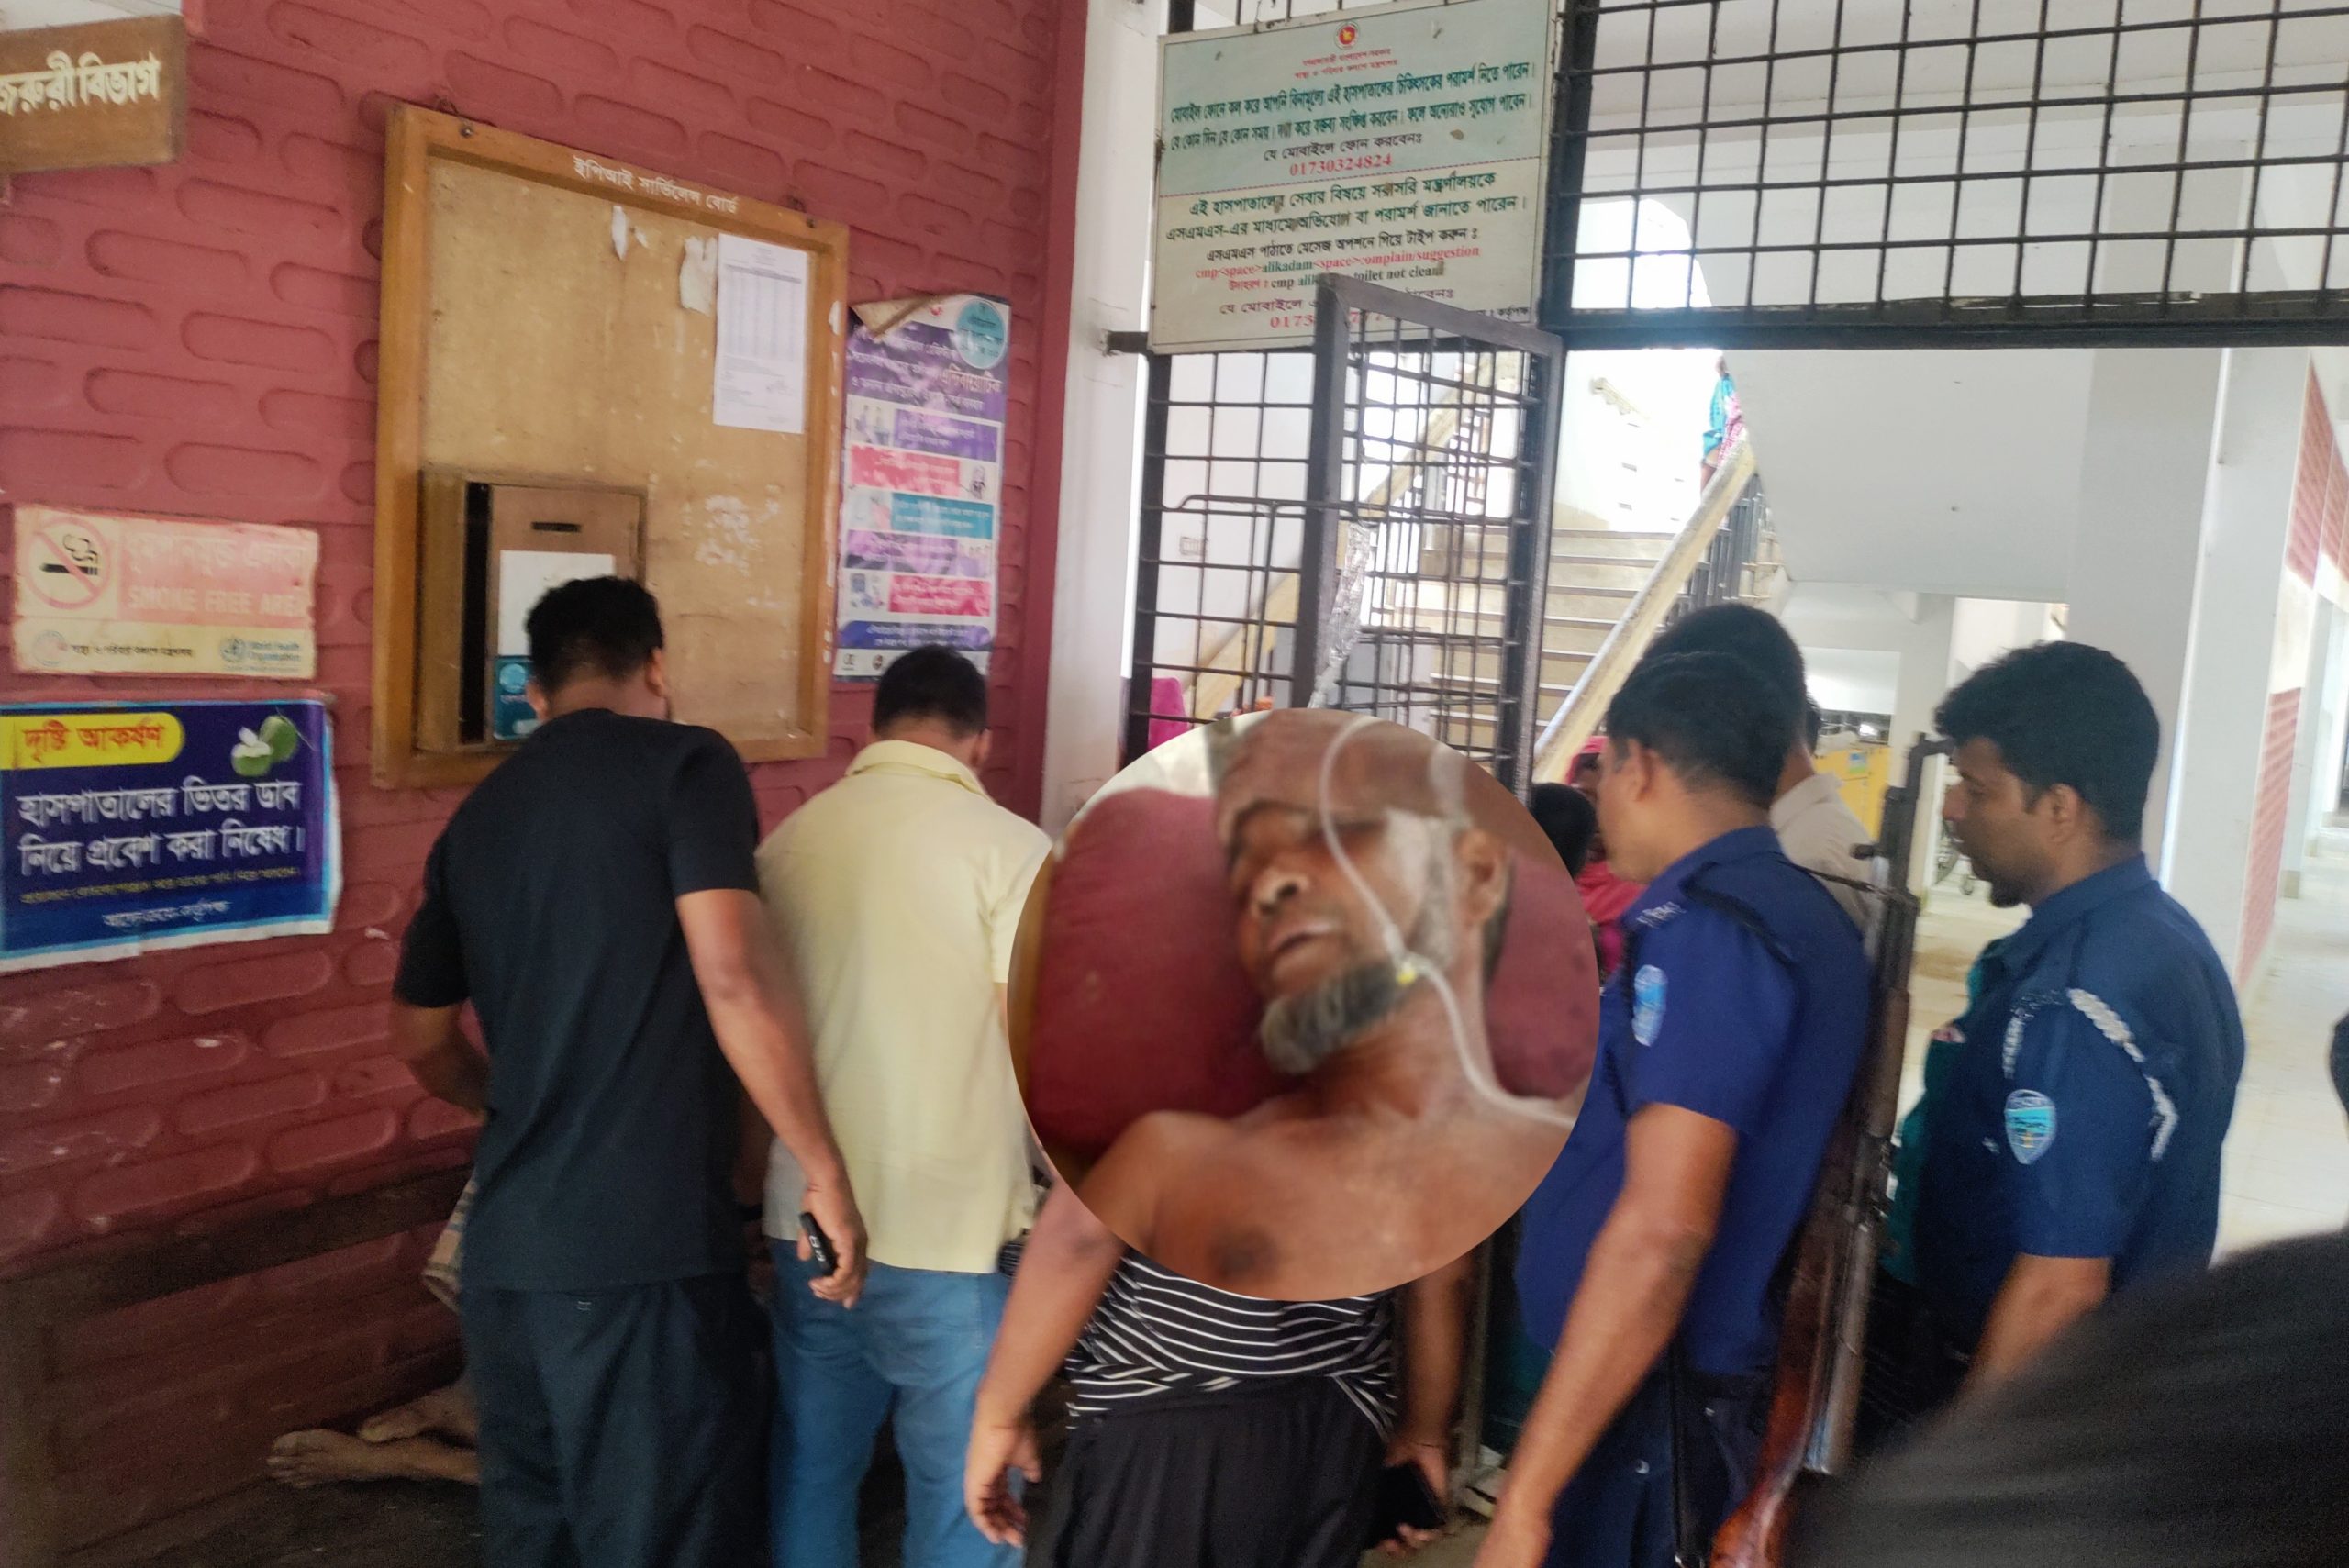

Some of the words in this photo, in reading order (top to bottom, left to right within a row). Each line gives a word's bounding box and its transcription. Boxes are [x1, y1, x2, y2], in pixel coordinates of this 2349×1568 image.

[77, 51, 161, 106] বিভাগ
[1171, 102, 1201, 123] মোবাইল
[1263, 90, 1287, 111] আপনি
[1328, 84, 1341, 103] এই
[1342, 81, 1395, 103] হাসপাতালের
[1478, 62, 1499, 83] নিতে
[1264, 149, 1278, 161] যে
[1282, 141, 1335, 160] মোবাইলে
[1340, 138, 1369, 152] ফোন
[1289, 153, 1393, 176] 01730324824
[705, 194, 740, 214] বোর্ড
[1189, 199, 1208, 217] এই
[1212, 193, 1285, 214] হাসপাতালের
[1289, 190, 1326, 208] সেবার
[1330, 183, 1367, 204] বিষয়ে
[1165, 222, 1249, 241] এসএমএস-এর
[1356, 209, 1369, 225] বা
[1375, 200, 1418, 223] পরামর্শ
[1423, 200, 1472, 218] জানাতে
[1207, 247, 1255, 261] এসএমএস
[1260, 239, 1293, 258] পাঠাতে
[1297, 240, 1332, 254] মেসেজ
[1336, 235, 1375, 250] অপশনে
[1378, 230, 1403, 248] গিয়ে
[1407, 228, 1435, 245] টাইপ
[1271, 277, 1295, 290] cmp
[1386, 269, 1406, 279] not
[1219, 304, 1235, 315] যে
[1241, 298, 1302, 313] মোবাইলে
[16, 788, 180, 827] হাসপাতালের
[182, 775, 254, 815] ভিতর
[255, 781, 302, 810] ডাব
[18, 834, 84, 876] নিয়ে
[165, 830, 217, 860] করা
